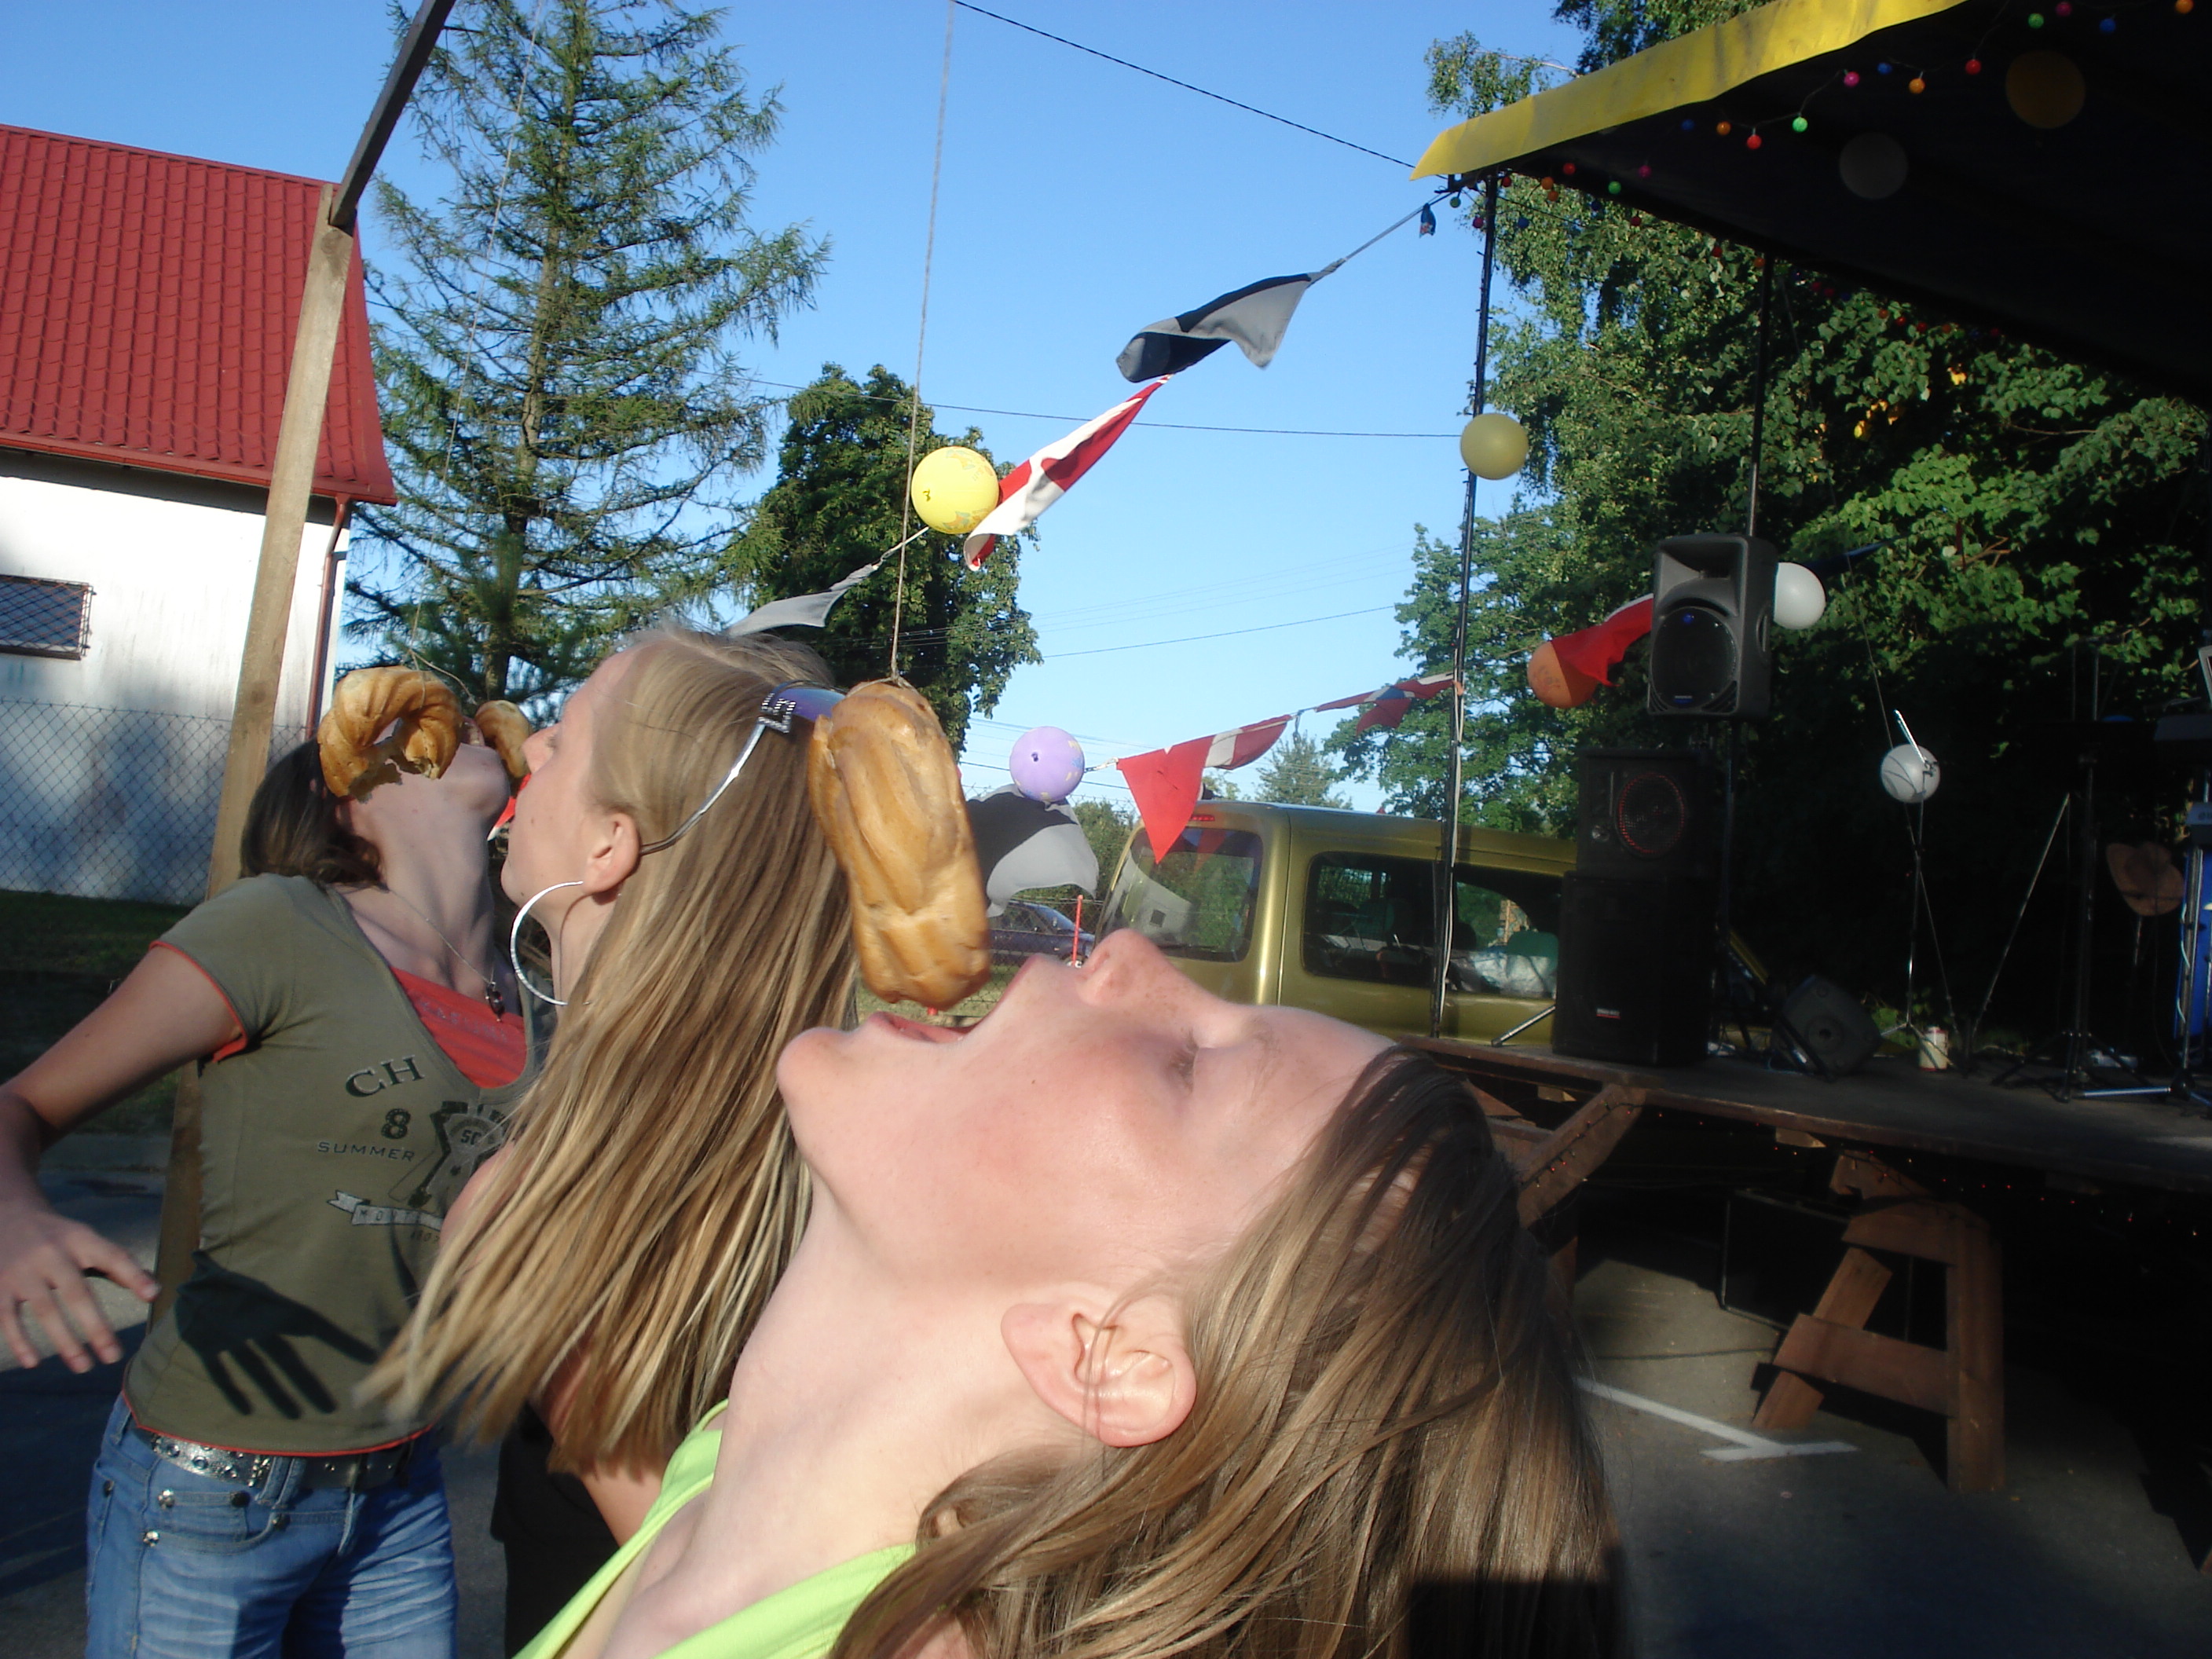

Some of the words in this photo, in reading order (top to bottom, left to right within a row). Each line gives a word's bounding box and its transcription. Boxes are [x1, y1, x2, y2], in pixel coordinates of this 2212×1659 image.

[346, 1055, 424, 1097] CH
[381, 1108, 412, 1140] 8
[317, 1141, 416, 1162] SUMMER
